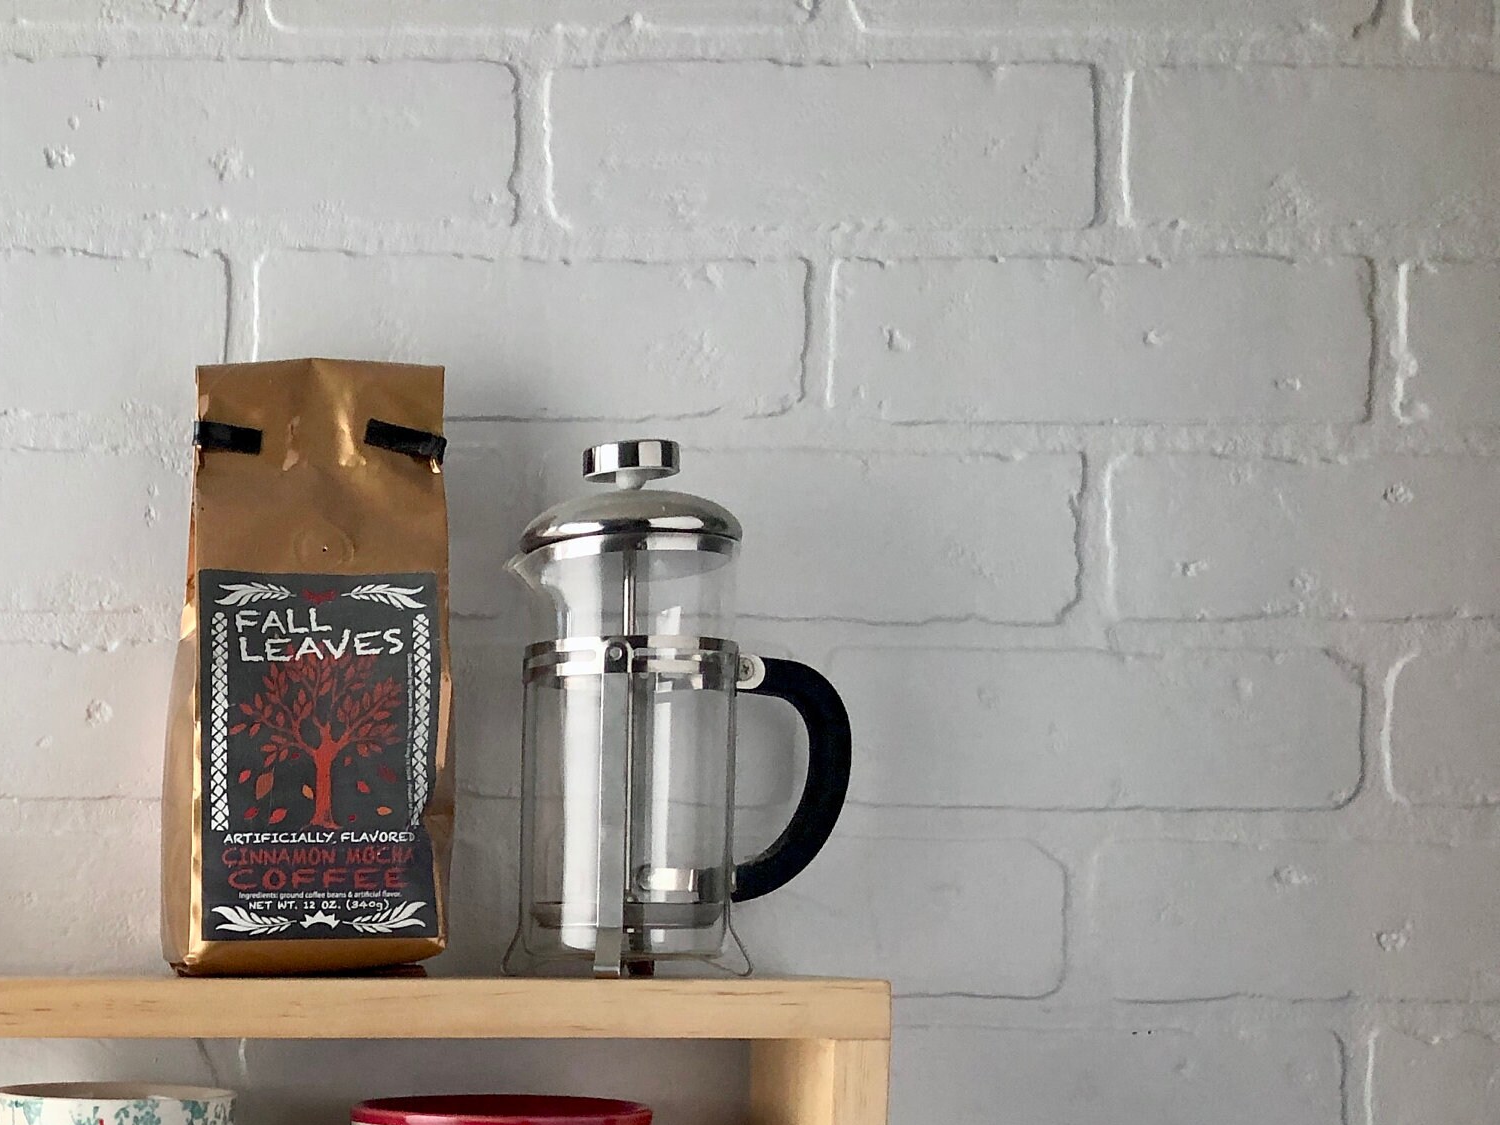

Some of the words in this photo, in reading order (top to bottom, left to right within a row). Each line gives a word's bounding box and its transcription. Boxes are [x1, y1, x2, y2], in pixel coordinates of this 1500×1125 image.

[235, 607, 333, 635] FALL
[238, 628, 404, 663] LEAVES
[223, 831, 336, 845] ARTIFICIALLY
[340, 831, 416, 843] FLAVORED
[221, 846, 336, 867] CINNAMON
[346, 845, 415, 866] MOCHA
[227, 867, 410, 891] COFFEE
[248, 901, 273, 910] NET
[277, 900, 298, 910] WT.
[303, 901, 316, 909] 12
[321, 900, 342, 910] OZ.
[346, 898, 390, 912] (340g)
[279, 891, 304, 900] ground
[304, 890, 326, 899] coffee
[326, 891, 346, 899] beans
[353, 890, 381, 899] artificial
